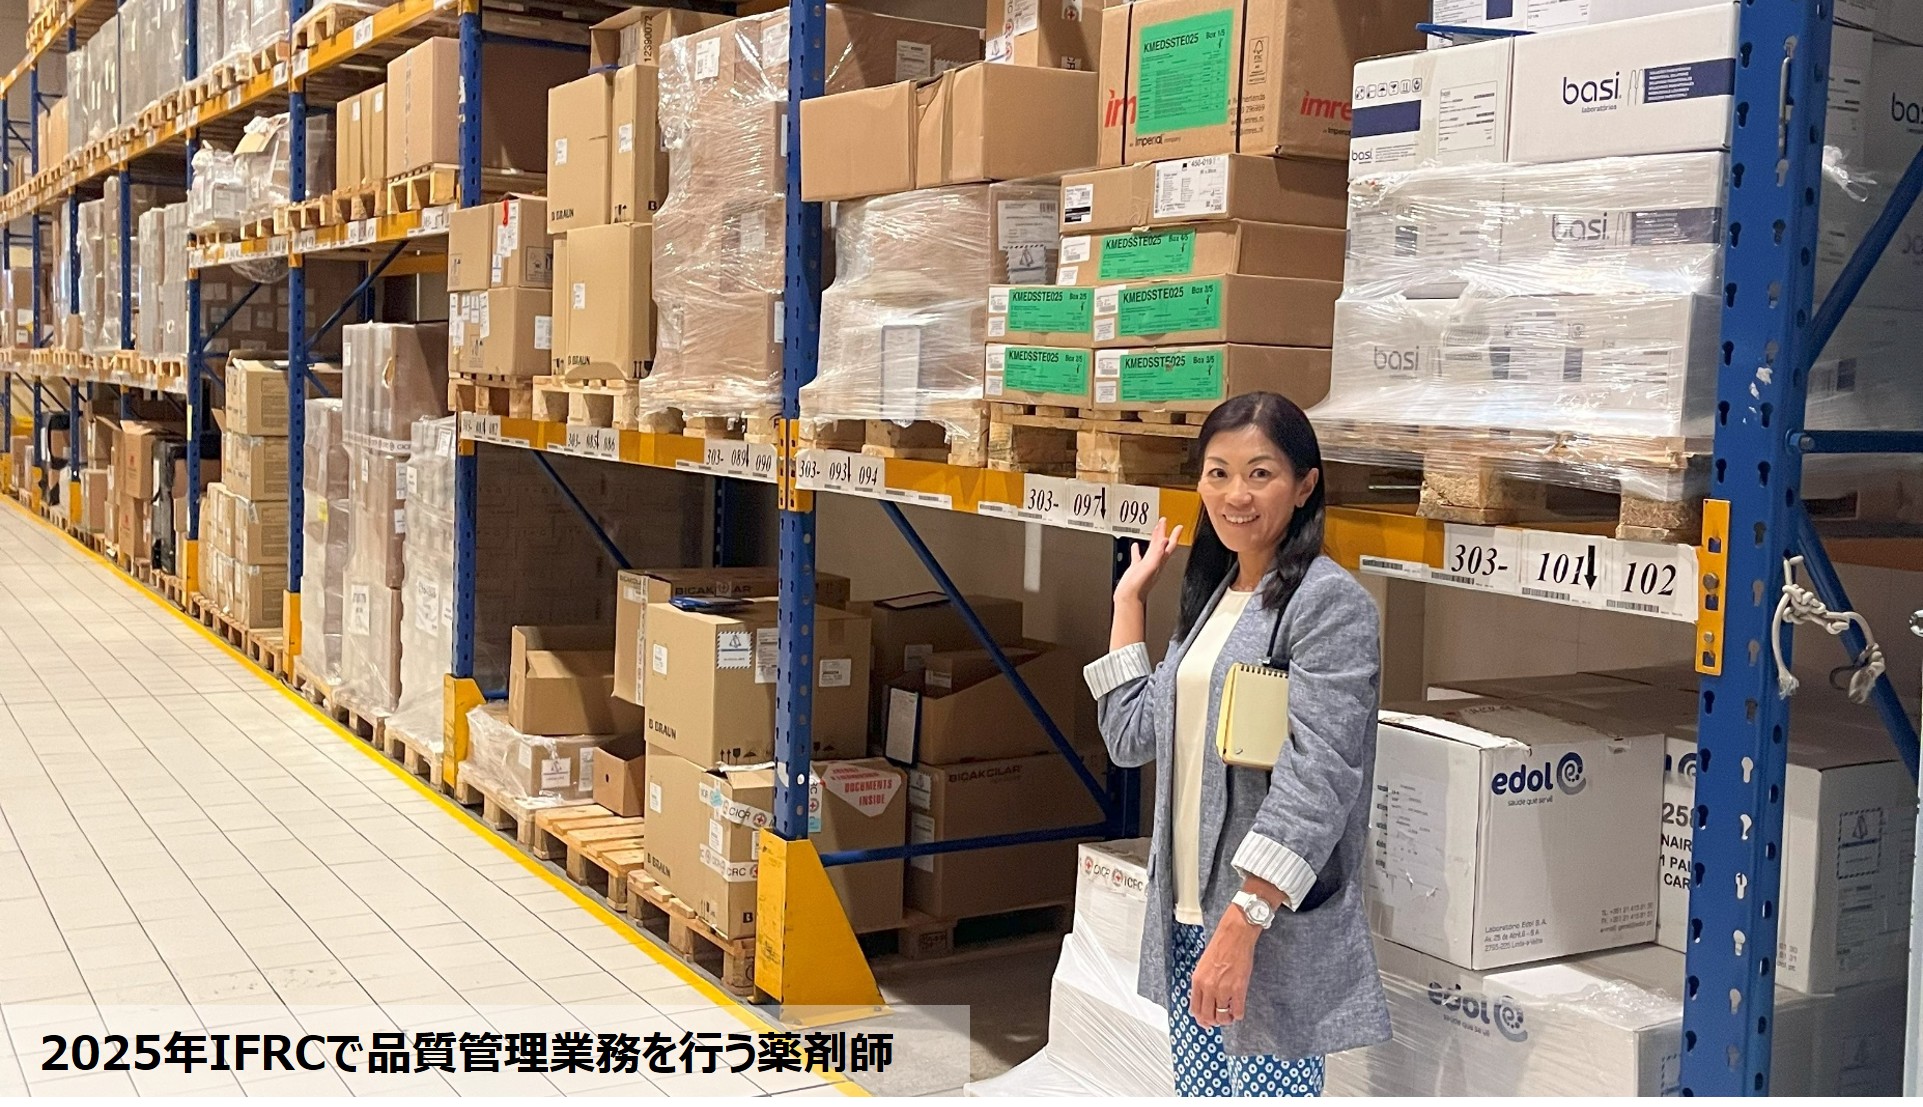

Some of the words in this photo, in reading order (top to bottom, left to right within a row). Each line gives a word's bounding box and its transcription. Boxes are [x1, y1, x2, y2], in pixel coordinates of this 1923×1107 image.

[644, 15, 653, 62] 12390072
[1143, 32, 1199, 53] KMEDSSTE025
[1206, 31, 1217, 39] Box
[1562, 71, 1621, 105] basi
[1351, 147, 1373, 161] basi
[1551, 212, 1609, 242] basi
[1106, 235, 1162, 250] KMEDSSTE025
[1168, 234, 1179, 243] Box
[1012, 291, 1063, 302] KMEDSSTE025
[1069, 292, 1079, 300] Box
[1123, 286, 1184, 303] KMEDSSTE025
[1191, 286, 1203, 294] Box
[1008, 350, 1059, 362] KMEDSSTE025
[1065, 354, 1075, 362] Box
[1125, 356, 1186, 369] KMEDSSTE025
[1193, 356, 1204, 364] Box
[1373, 345, 1420, 371] basi
[567, 433, 581, 448] 303-
[705, 449, 724, 466] 303-
[730, 449, 747, 467] 089
[755, 454, 772, 472] 090
[798, 460, 821, 478] 303-
[828, 462, 848, 481] 093
[858, 466, 878, 486] 094
[1027, 488, 1059, 512] 303-
[1073, 493, 1102, 517] 097
[1119, 500, 1150, 525] 098
[1451, 543, 1508, 577] 303-
[1536, 552, 1585, 587] 101
[1621, 561, 1677, 597] 102
[654, 721, 677, 740] BRAUN
[844, 779, 893, 793] DOCUMENTS
[1491, 762, 1554, 796] edol
[859, 794, 885, 806] INSIDE
[1662, 802, 1694, 829] 25
[1428, 981, 1491, 1025] edol
